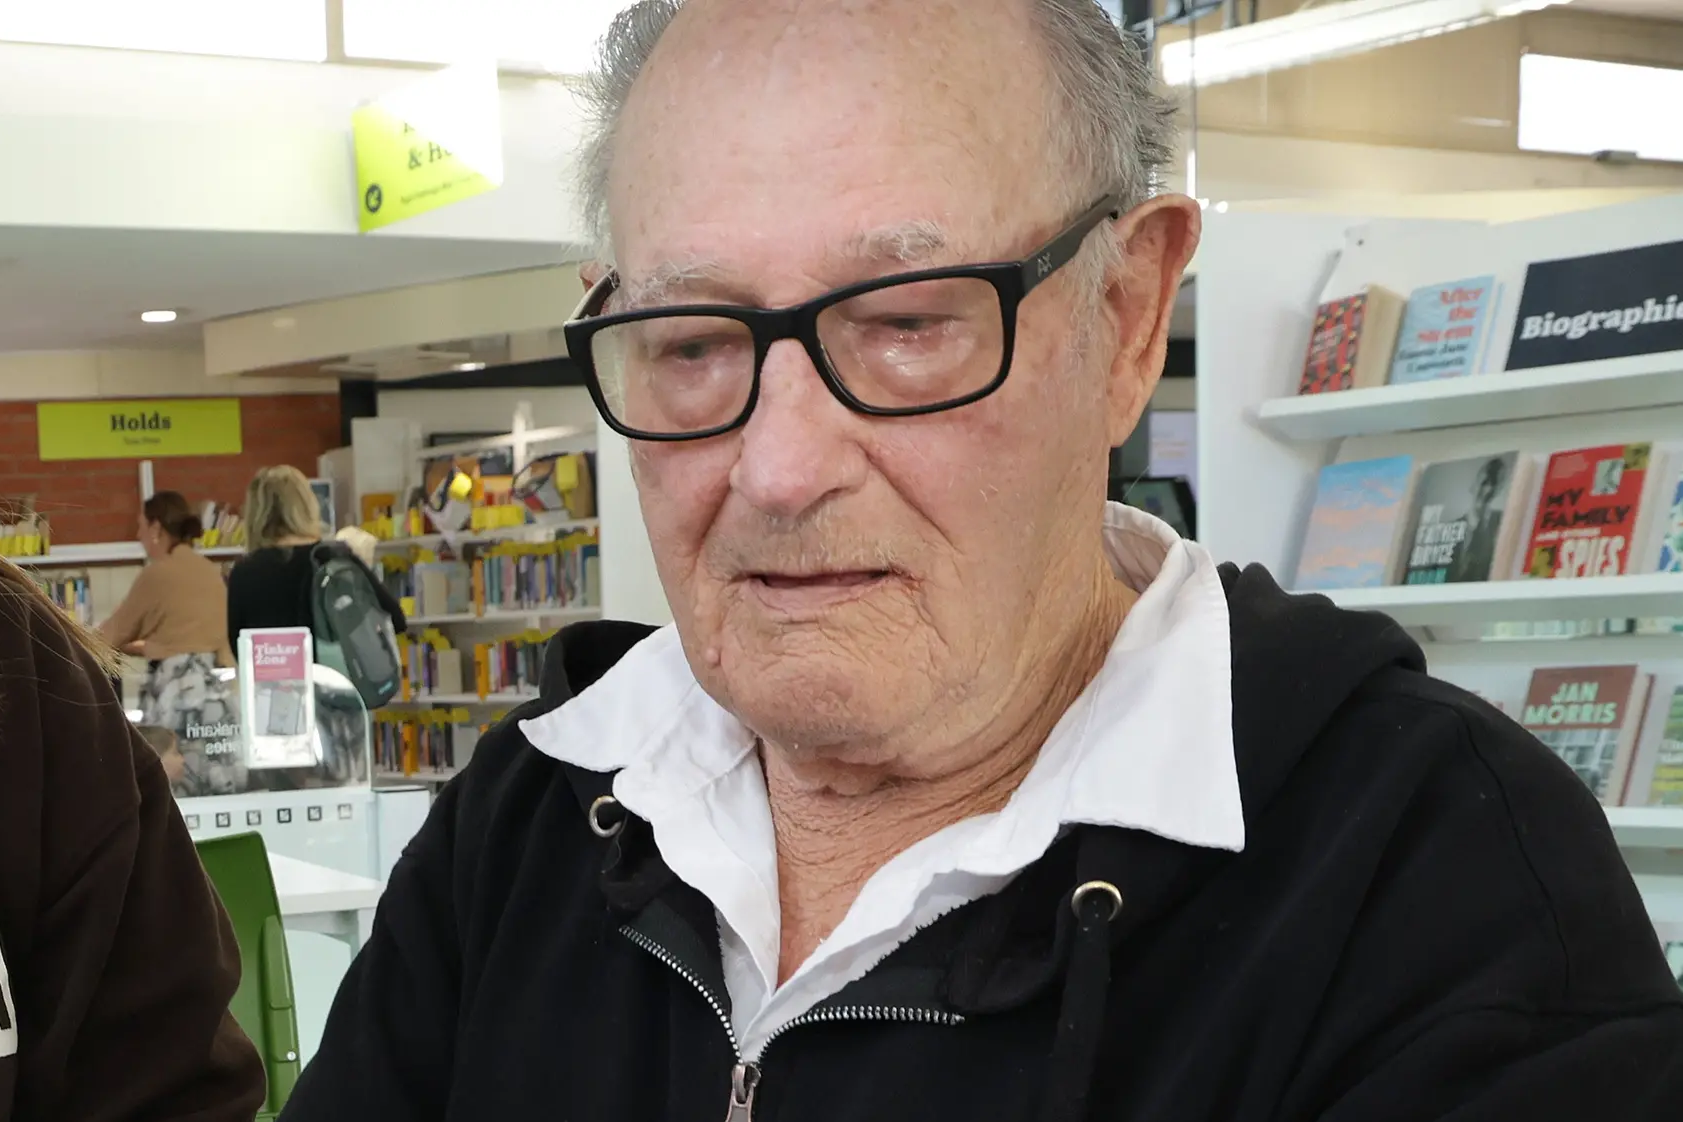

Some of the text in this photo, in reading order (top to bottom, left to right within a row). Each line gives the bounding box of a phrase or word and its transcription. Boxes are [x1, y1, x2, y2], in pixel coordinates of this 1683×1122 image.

[110, 410, 172, 432] Holds
[254, 642, 300, 656] Tinker
[1550, 682, 1599, 704] JAN
[1523, 702, 1618, 725] MORRIS
